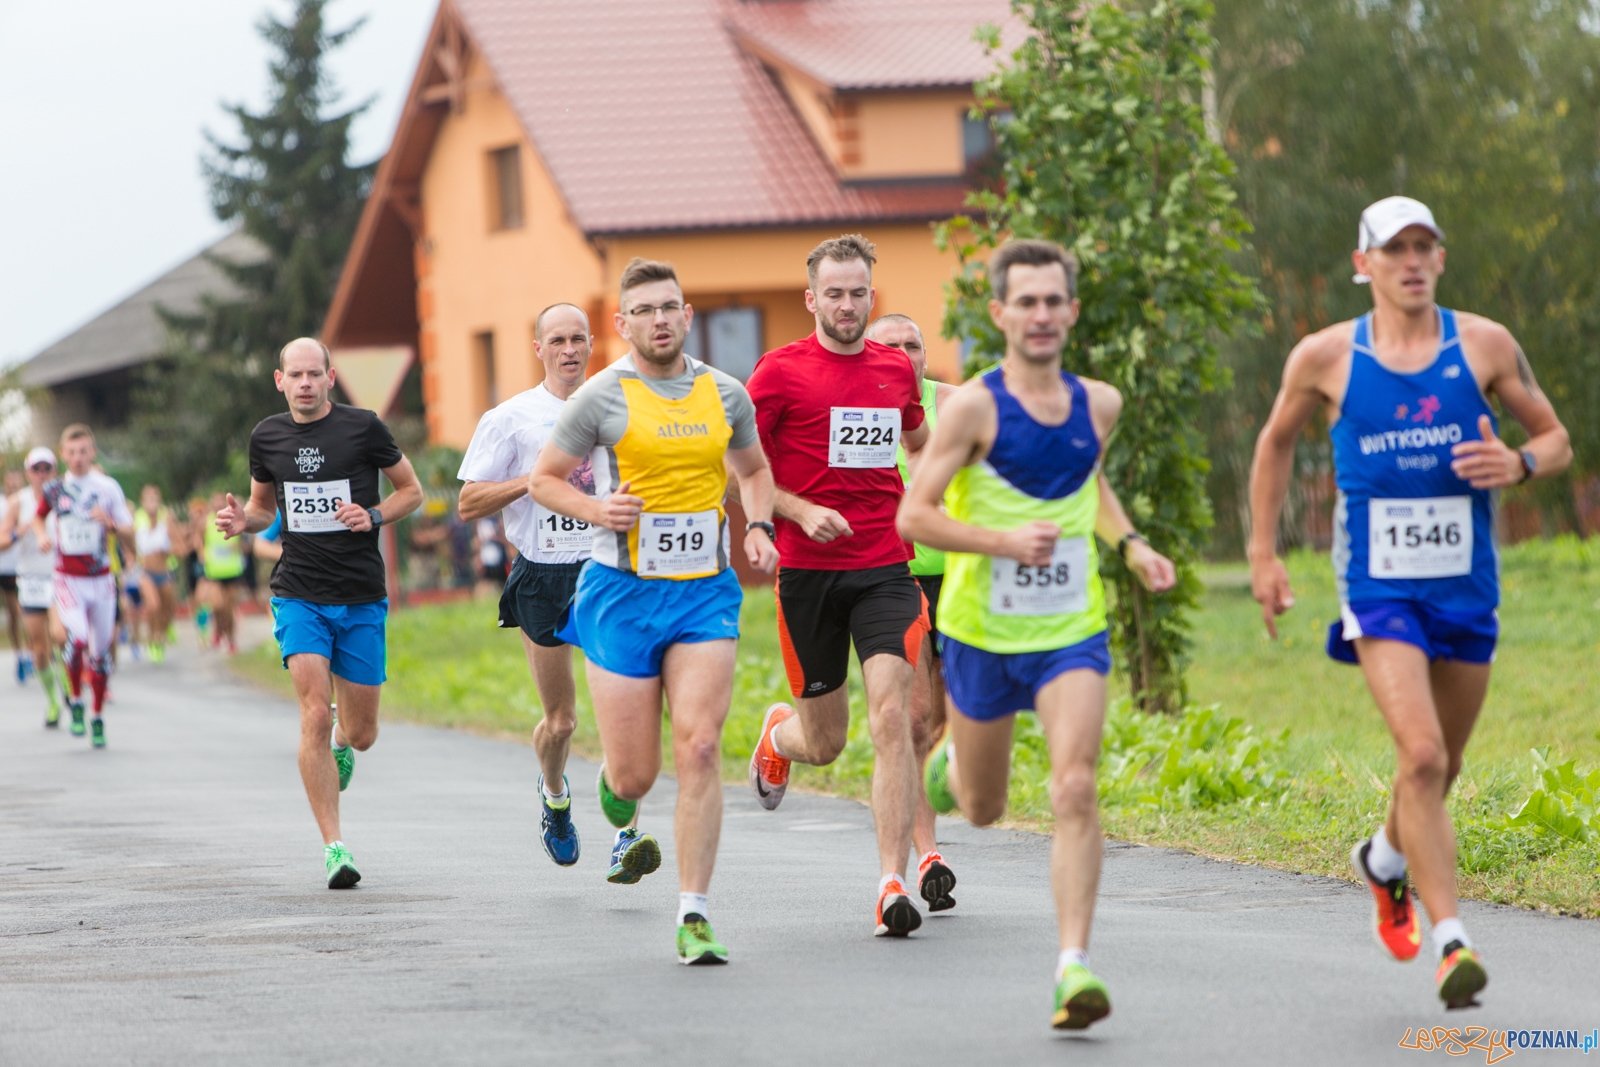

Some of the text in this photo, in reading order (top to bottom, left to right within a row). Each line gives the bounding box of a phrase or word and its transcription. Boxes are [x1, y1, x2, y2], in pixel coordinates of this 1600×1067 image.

[839, 426, 894, 446] 2224
[1358, 423, 1462, 455] WITKOWO
[294, 455, 325, 465] VERDAN
[298, 447, 320, 456] DOM
[299, 464, 321, 473] LOOP
[292, 496, 343, 514] 2538
[546, 514, 595, 532] 189
[658, 531, 704, 553] 519
[1385, 522, 1462, 548] 1546
[1015, 562, 1069, 587] 558
